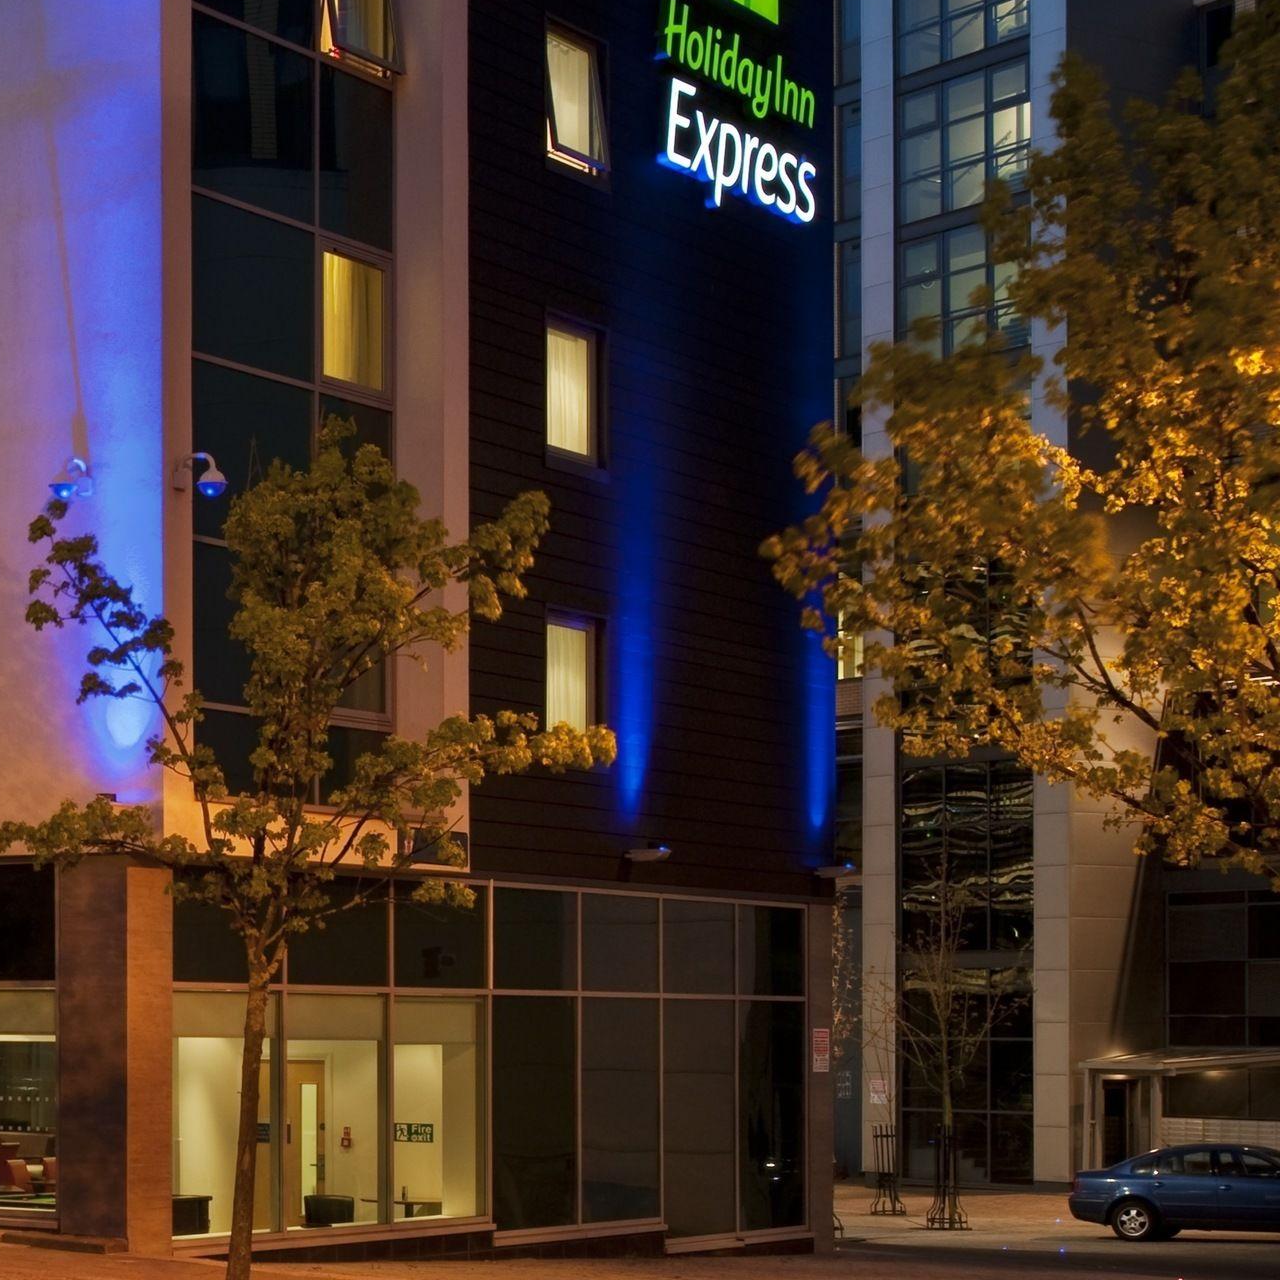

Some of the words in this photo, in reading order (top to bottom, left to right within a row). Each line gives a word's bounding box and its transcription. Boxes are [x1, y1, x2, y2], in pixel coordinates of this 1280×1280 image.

[774, 54, 815, 128] Inn
[666, 77, 816, 222] Express
[410, 1133, 431, 1142] exit
[411, 1124, 432, 1134] Fire
